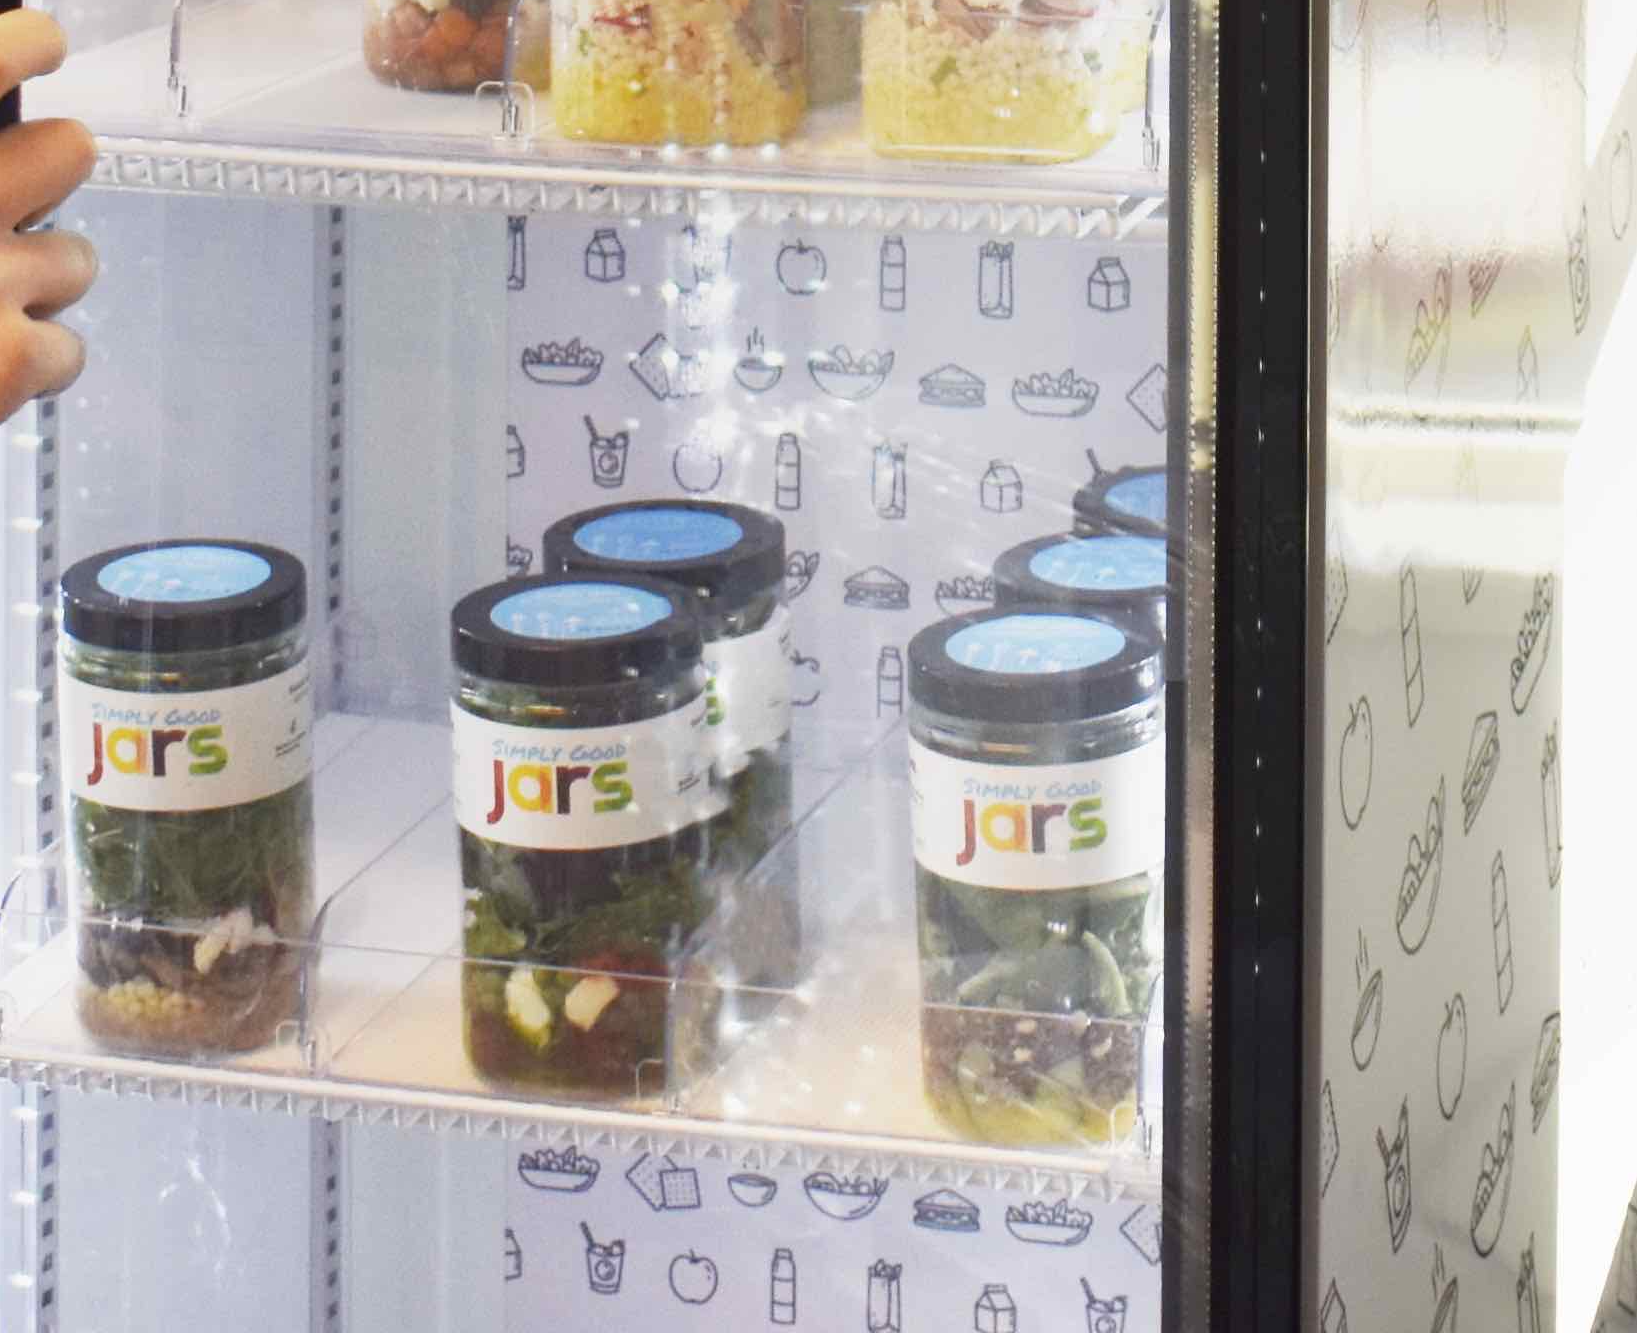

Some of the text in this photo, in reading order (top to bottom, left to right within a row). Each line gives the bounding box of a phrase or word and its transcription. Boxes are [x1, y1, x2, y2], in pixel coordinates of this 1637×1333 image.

[165, 709, 221, 726] GOOD
[492, 740, 628, 762] SIMPLY GOOD
[963, 778, 1102, 800] SIMPLY GOOD
